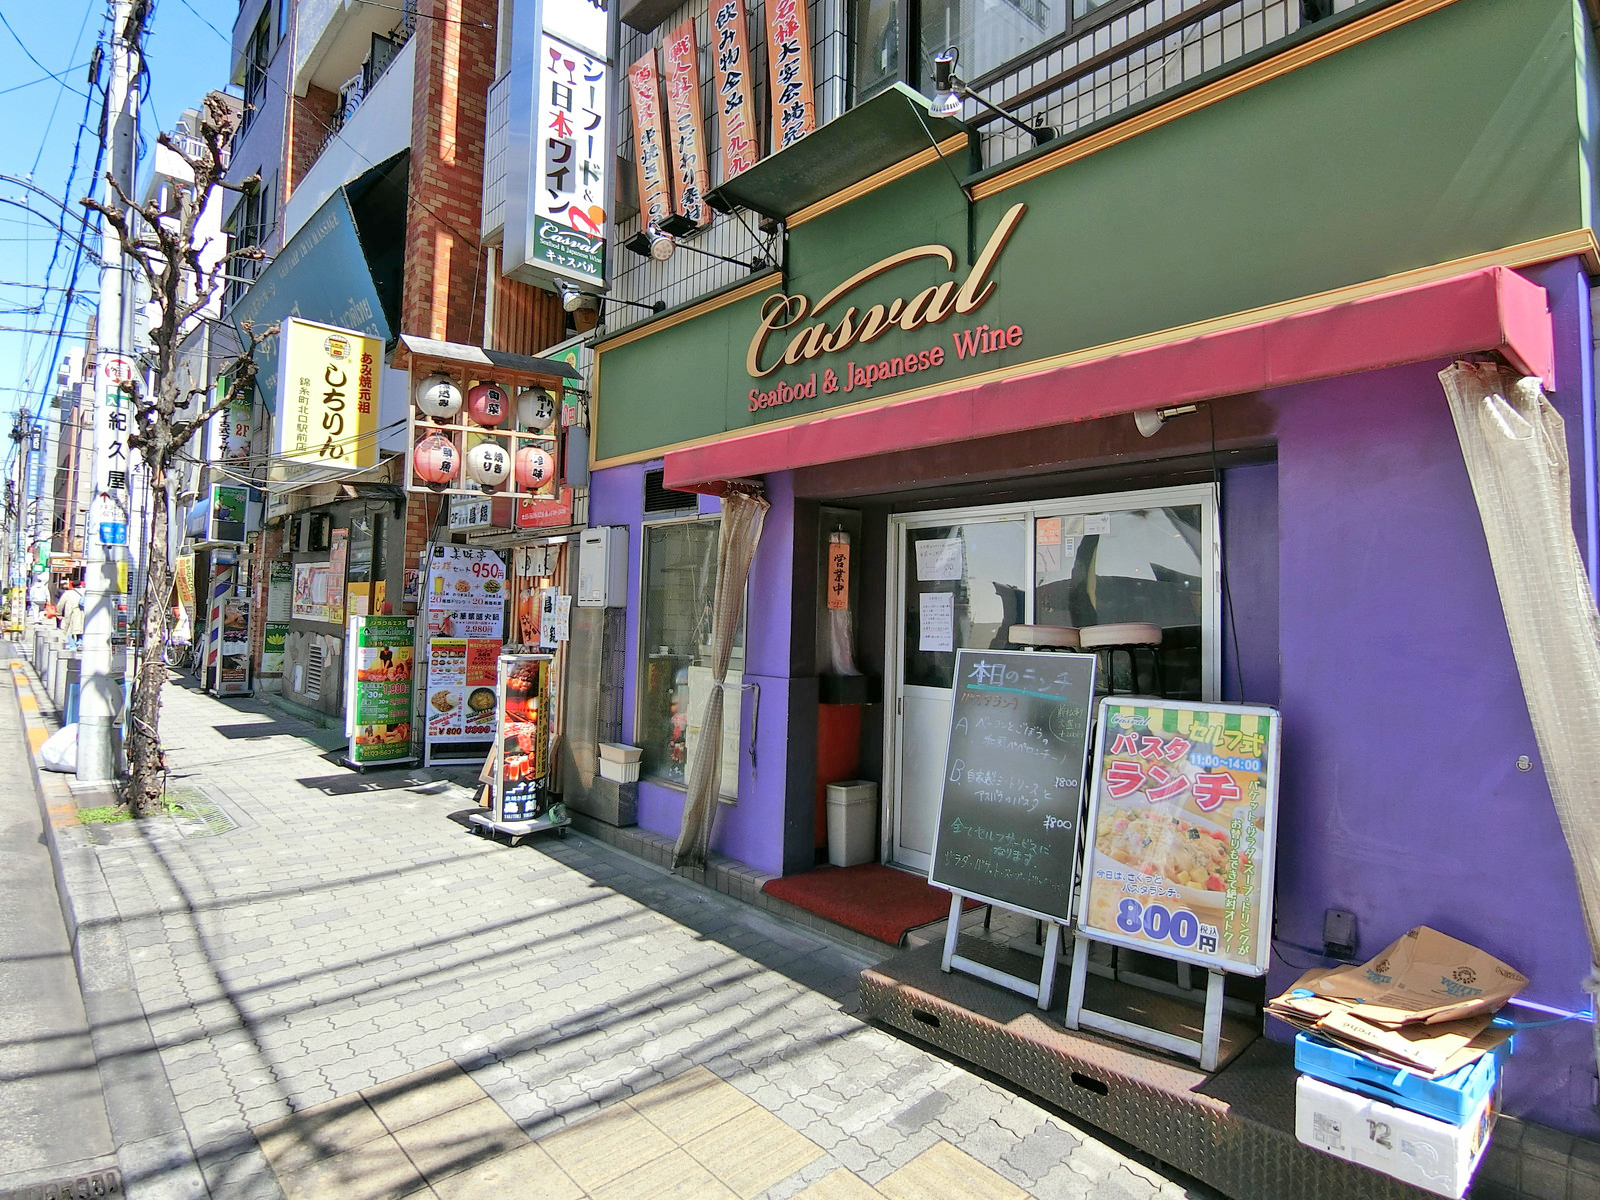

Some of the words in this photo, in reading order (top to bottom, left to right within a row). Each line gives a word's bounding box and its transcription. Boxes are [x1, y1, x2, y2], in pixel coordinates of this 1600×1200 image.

[546, 81, 574, 215] 日本ワイン
[540, 221, 604, 255] Casval
[540, 238, 560, 251] Seafood
[566, 247, 589, 260] Japanese
[589, 253, 602, 264] Wine
[545, 249, 597, 274] キャスバル
[746, 202, 1028, 378] Casval
[357, 352, 373, 414] あみ焼元祖
[748, 372, 817, 412] Seafood
[821, 368, 839, 395] &
[843, 346, 944, 392] Japanese
[952, 323, 1023, 361] Wine
[296, 376, 311, 452] 錦糸町北口駅前店
[320, 362, 347, 460] しちりん
[236, 423, 250, 438] 2F
[108, 411, 127, 490] 紀久屋
[450, 547, 487, 562] 美味亭
[833, 553, 847, 596] 営業中
[1110, 713, 1152, 727] Casval
[1110, 731, 1191, 763] パスタ
[1188, 720, 1265, 758] セルフ式
[1054, 776, 1078, 789] ¥800
[1105, 760, 1243, 813] ランチ
[1043, 814, 1072, 830] ¥800
[1115, 898, 1199, 947] 800
[1200, 924, 1218, 937] 税込
[1198, 935, 1219, 954] 円
